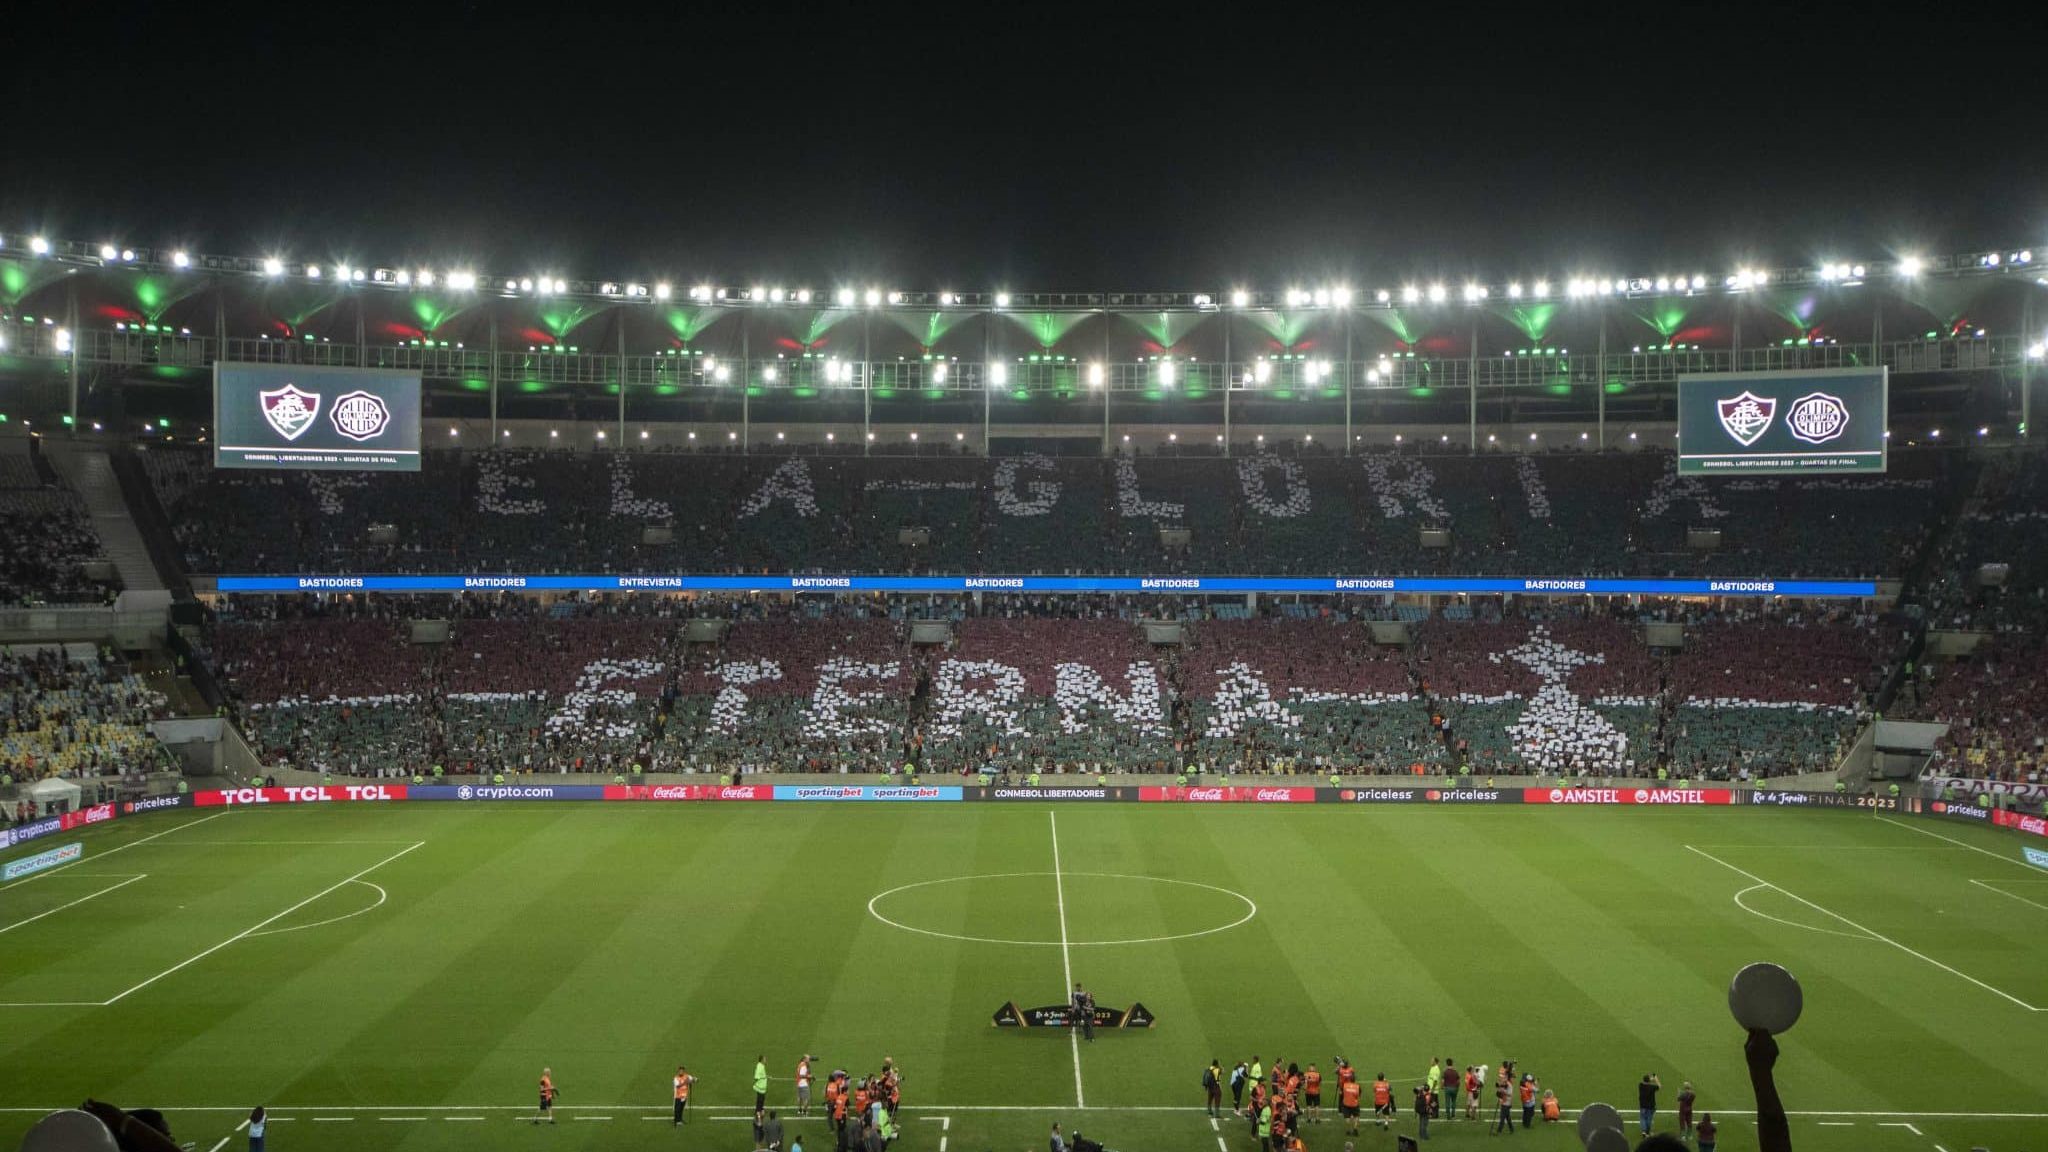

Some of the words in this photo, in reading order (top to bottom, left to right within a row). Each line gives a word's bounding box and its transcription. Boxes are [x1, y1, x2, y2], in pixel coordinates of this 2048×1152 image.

[299, 578, 364, 588] BASTIDORES
[464, 578, 527, 588] BASTIDORES
[619, 578, 682, 587] ENTREVISTAS
[792, 578, 850, 588] BASTIDORES
[965, 578, 1024, 588] BASTIDORES
[1141, 579, 1200, 588] BASTIDORES
[1336, 579, 1394, 589] BASTIDORES
[1525, 580, 1586, 590] BASTIDORES
[1710, 581, 1775, 592] BASTIDORES
[220, 789, 270, 804] TCL
[284, 787, 332, 801] TCL
[346, 785, 391, 800] TCL
[476, 786, 553, 799] crypto.com
[797, 787, 863, 798] sportingbet
[873, 787, 939, 798] sportingbet
[994, 789, 1041, 798] CONMEBOL
[1044, 789, 1105, 798] LIBERTADORES
[1357, 789, 1414, 801] priceless
[1442, 790, 1499, 802] priceless
[1564, 789, 1619, 803] AMSTEL
[1650, 790, 1705, 803] AMSTEL
[134, 796, 181, 812] priceless
[1752, 790, 1765, 804] Rio
[1808, 794, 1855, 806] FINAL
[1857, 797, 1896, 808] 2023
[1947, 804, 1988, 818] priceless
[18, 819, 61, 839] crypto.com
[7, 846, 79, 877] sportingbet
